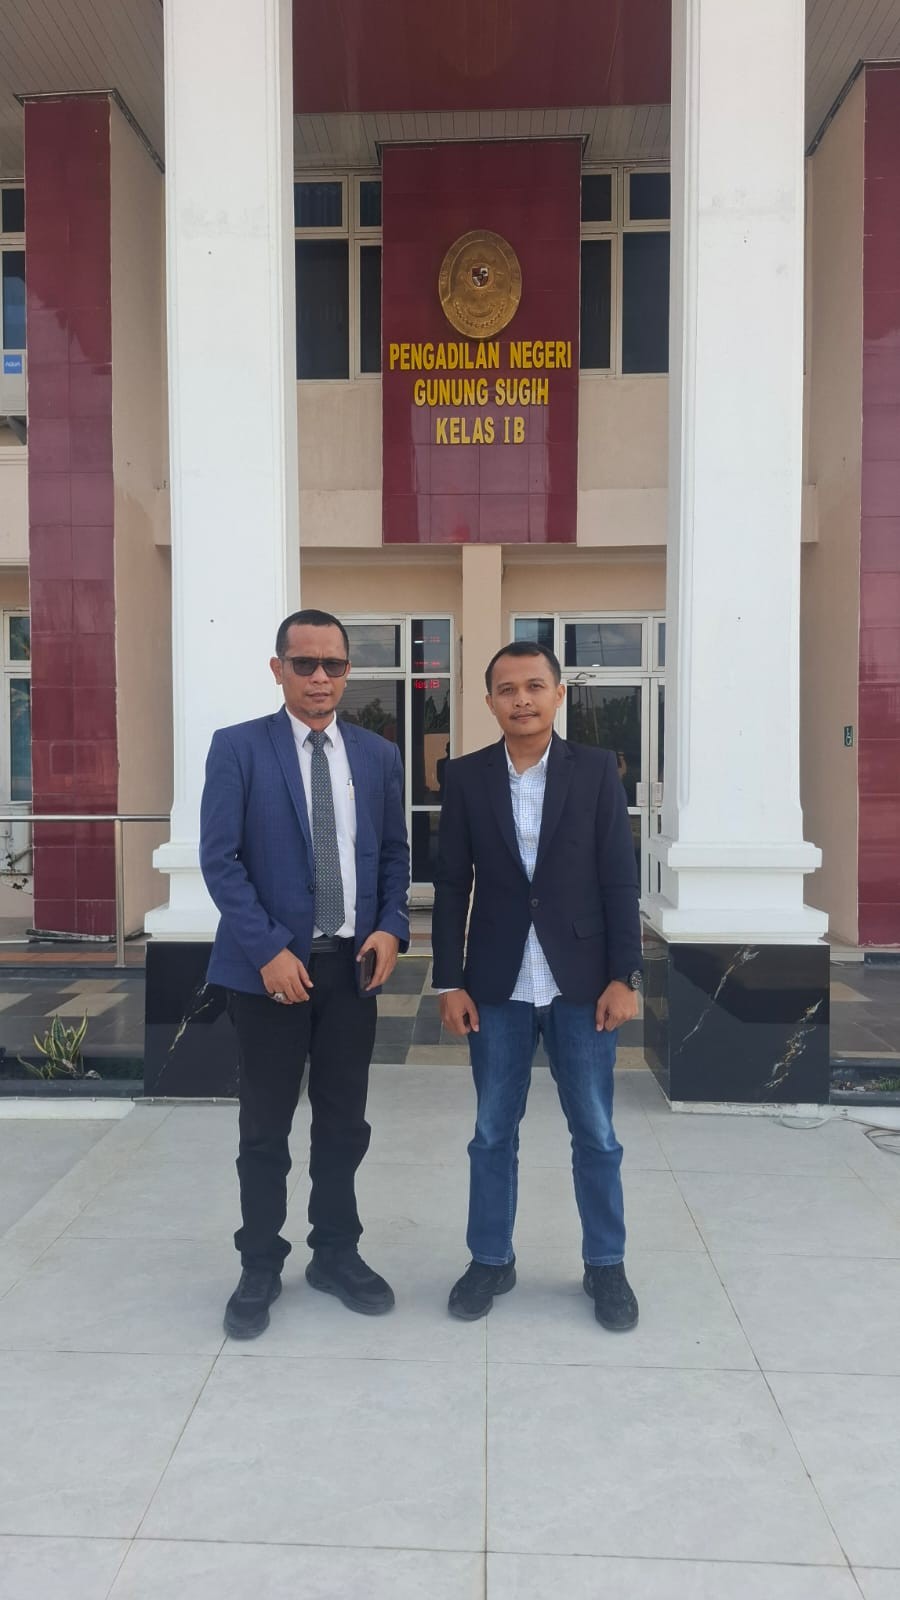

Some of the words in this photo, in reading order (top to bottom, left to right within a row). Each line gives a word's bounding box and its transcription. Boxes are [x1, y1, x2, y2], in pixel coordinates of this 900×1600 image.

[389, 341, 500, 370] PENGADILAN
[510, 341, 572, 369] NEGERI
[414, 378, 489, 406] GUNUNG
[495, 378, 549, 406] SUGIH
[436, 416, 495, 444] KELAS
